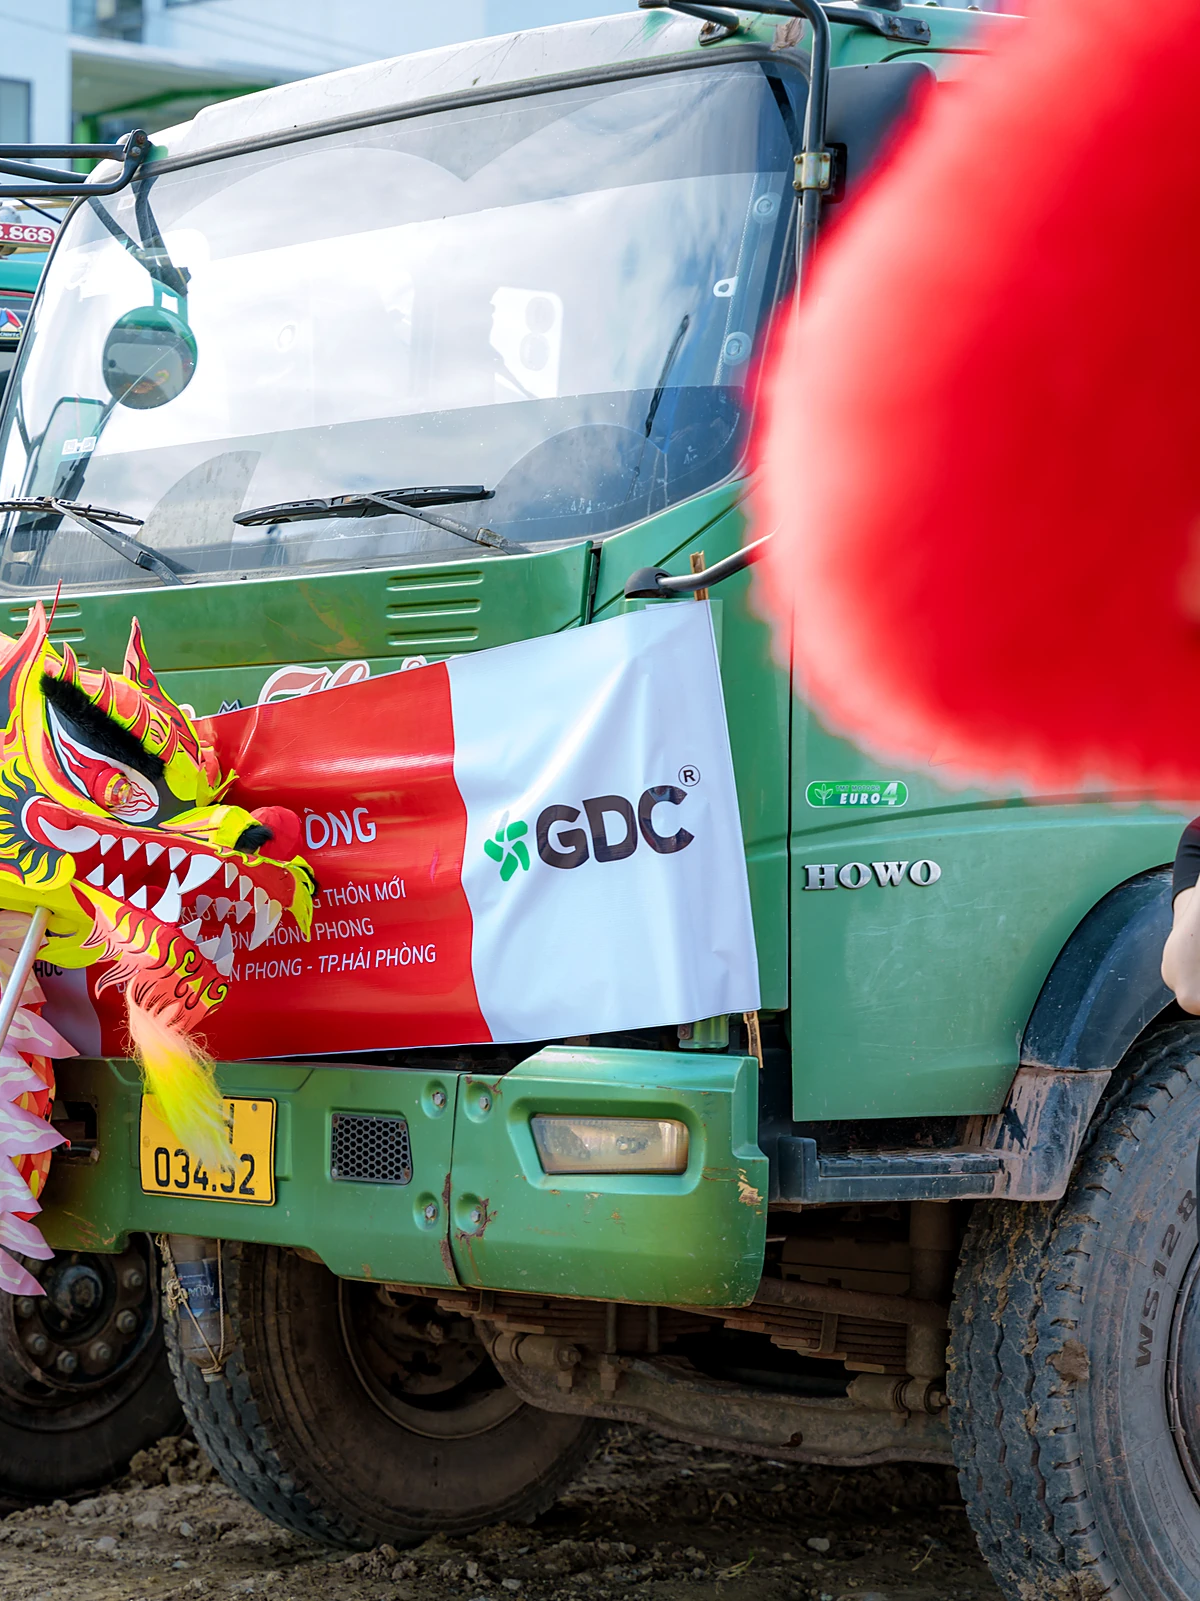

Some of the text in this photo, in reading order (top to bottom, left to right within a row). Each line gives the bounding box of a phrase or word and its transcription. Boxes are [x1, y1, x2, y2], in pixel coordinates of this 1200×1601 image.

[839, 782, 898, 806] EURO 4
[303, 807, 377, 850] ÔNG
[536, 784, 695, 869] GDC
[323, 882, 370, 908] THÔN
[375, 875, 406, 900] MỚI
[804, 859, 942, 890] HOWO
[315, 917, 374, 941] PHONG
[245, 958, 303, 981] PHONG
[319, 946, 370, 974] TP.HẢI
[375, 941, 437, 969] PHÒNG
[1135, 1189, 1198, 1369] WS128
